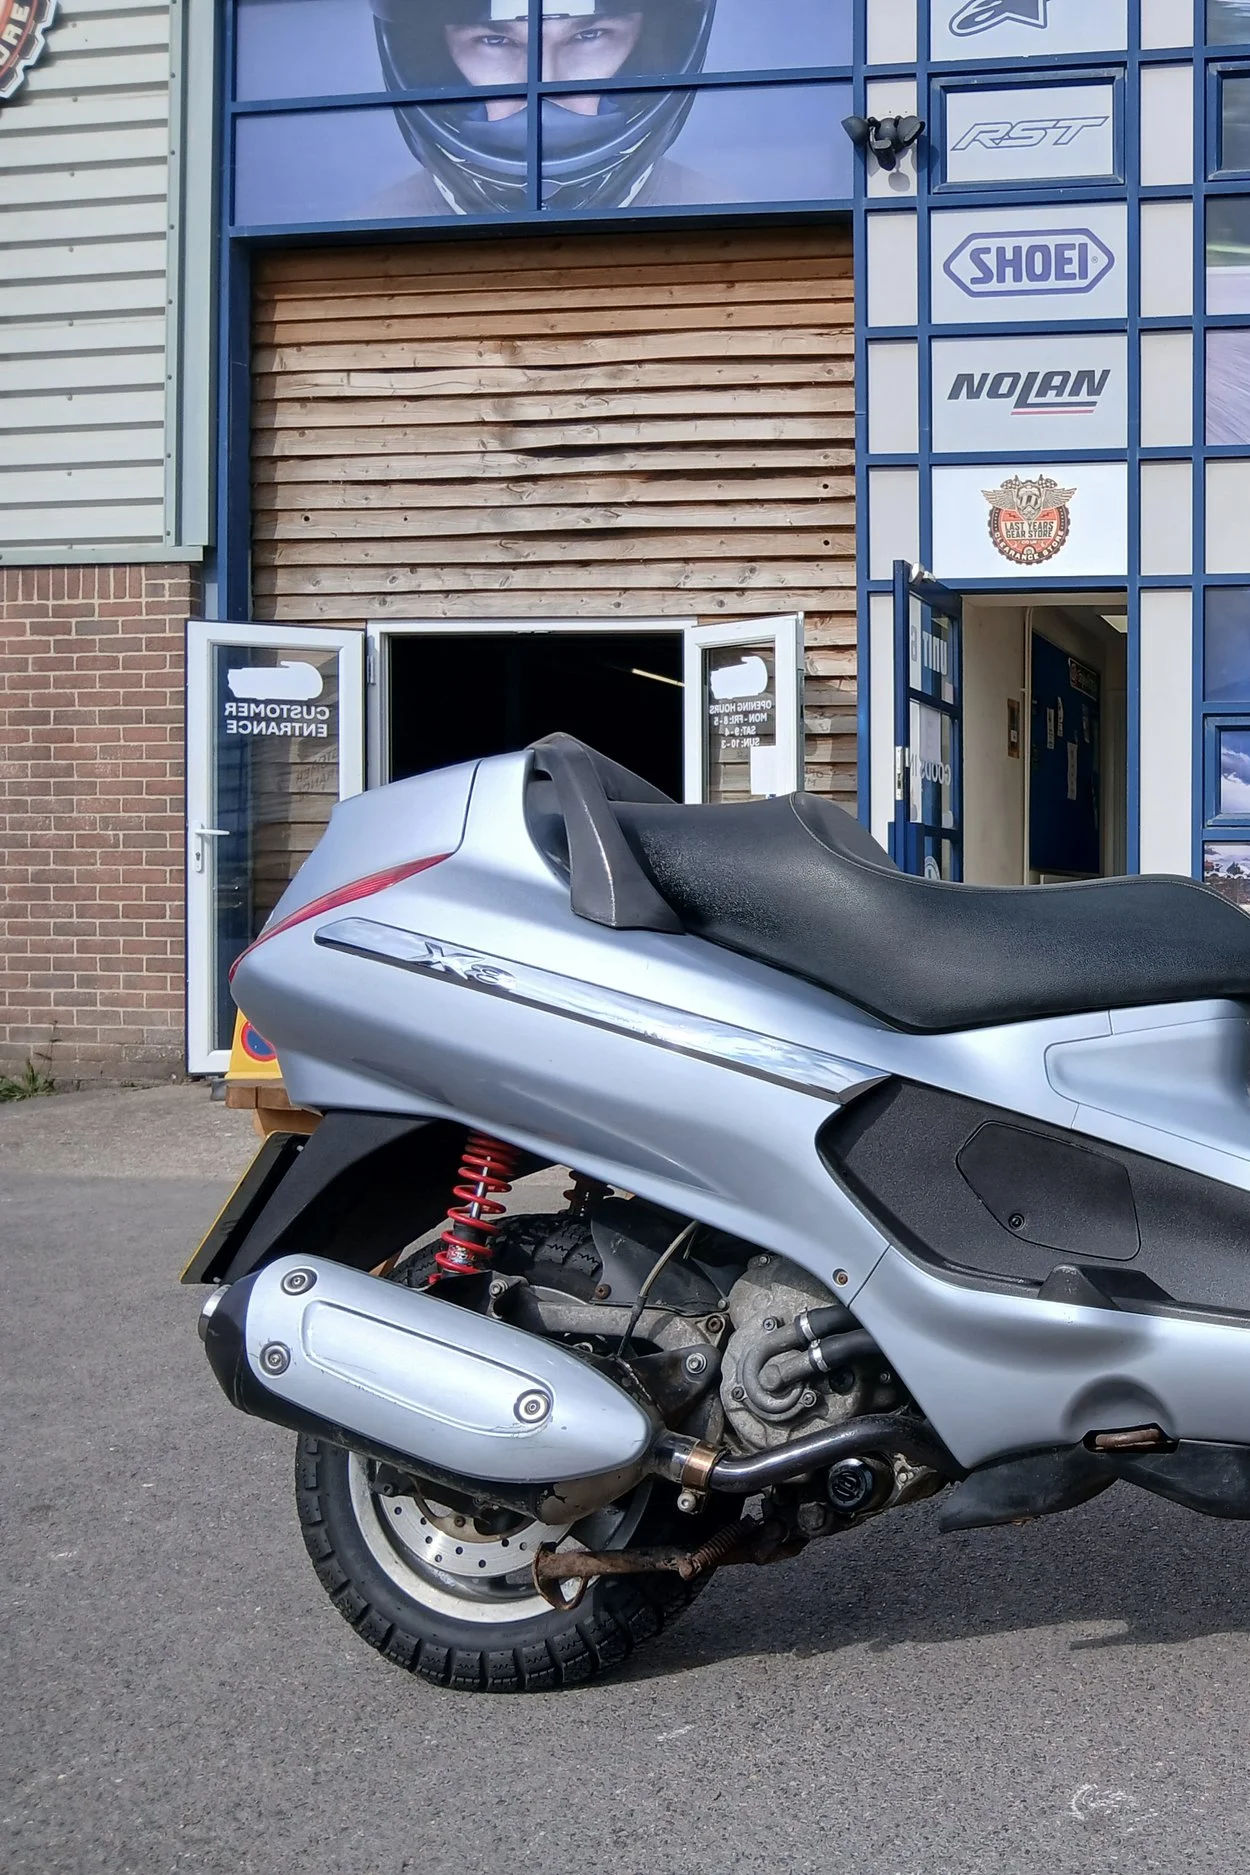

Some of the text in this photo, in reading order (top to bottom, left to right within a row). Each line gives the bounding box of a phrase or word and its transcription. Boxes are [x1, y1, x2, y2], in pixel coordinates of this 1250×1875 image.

[950, 116, 1110, 151] RST
[969, 242, 1089, 285] SHOEI
[947, 369, 1111, 409] NOLAN
[1004, 521, 1054, 530] LAST YEARS
[1006, 529, 1053, 539] GEAR STORE
[994, 530, 1064, 561] CLEARANCE STORE
